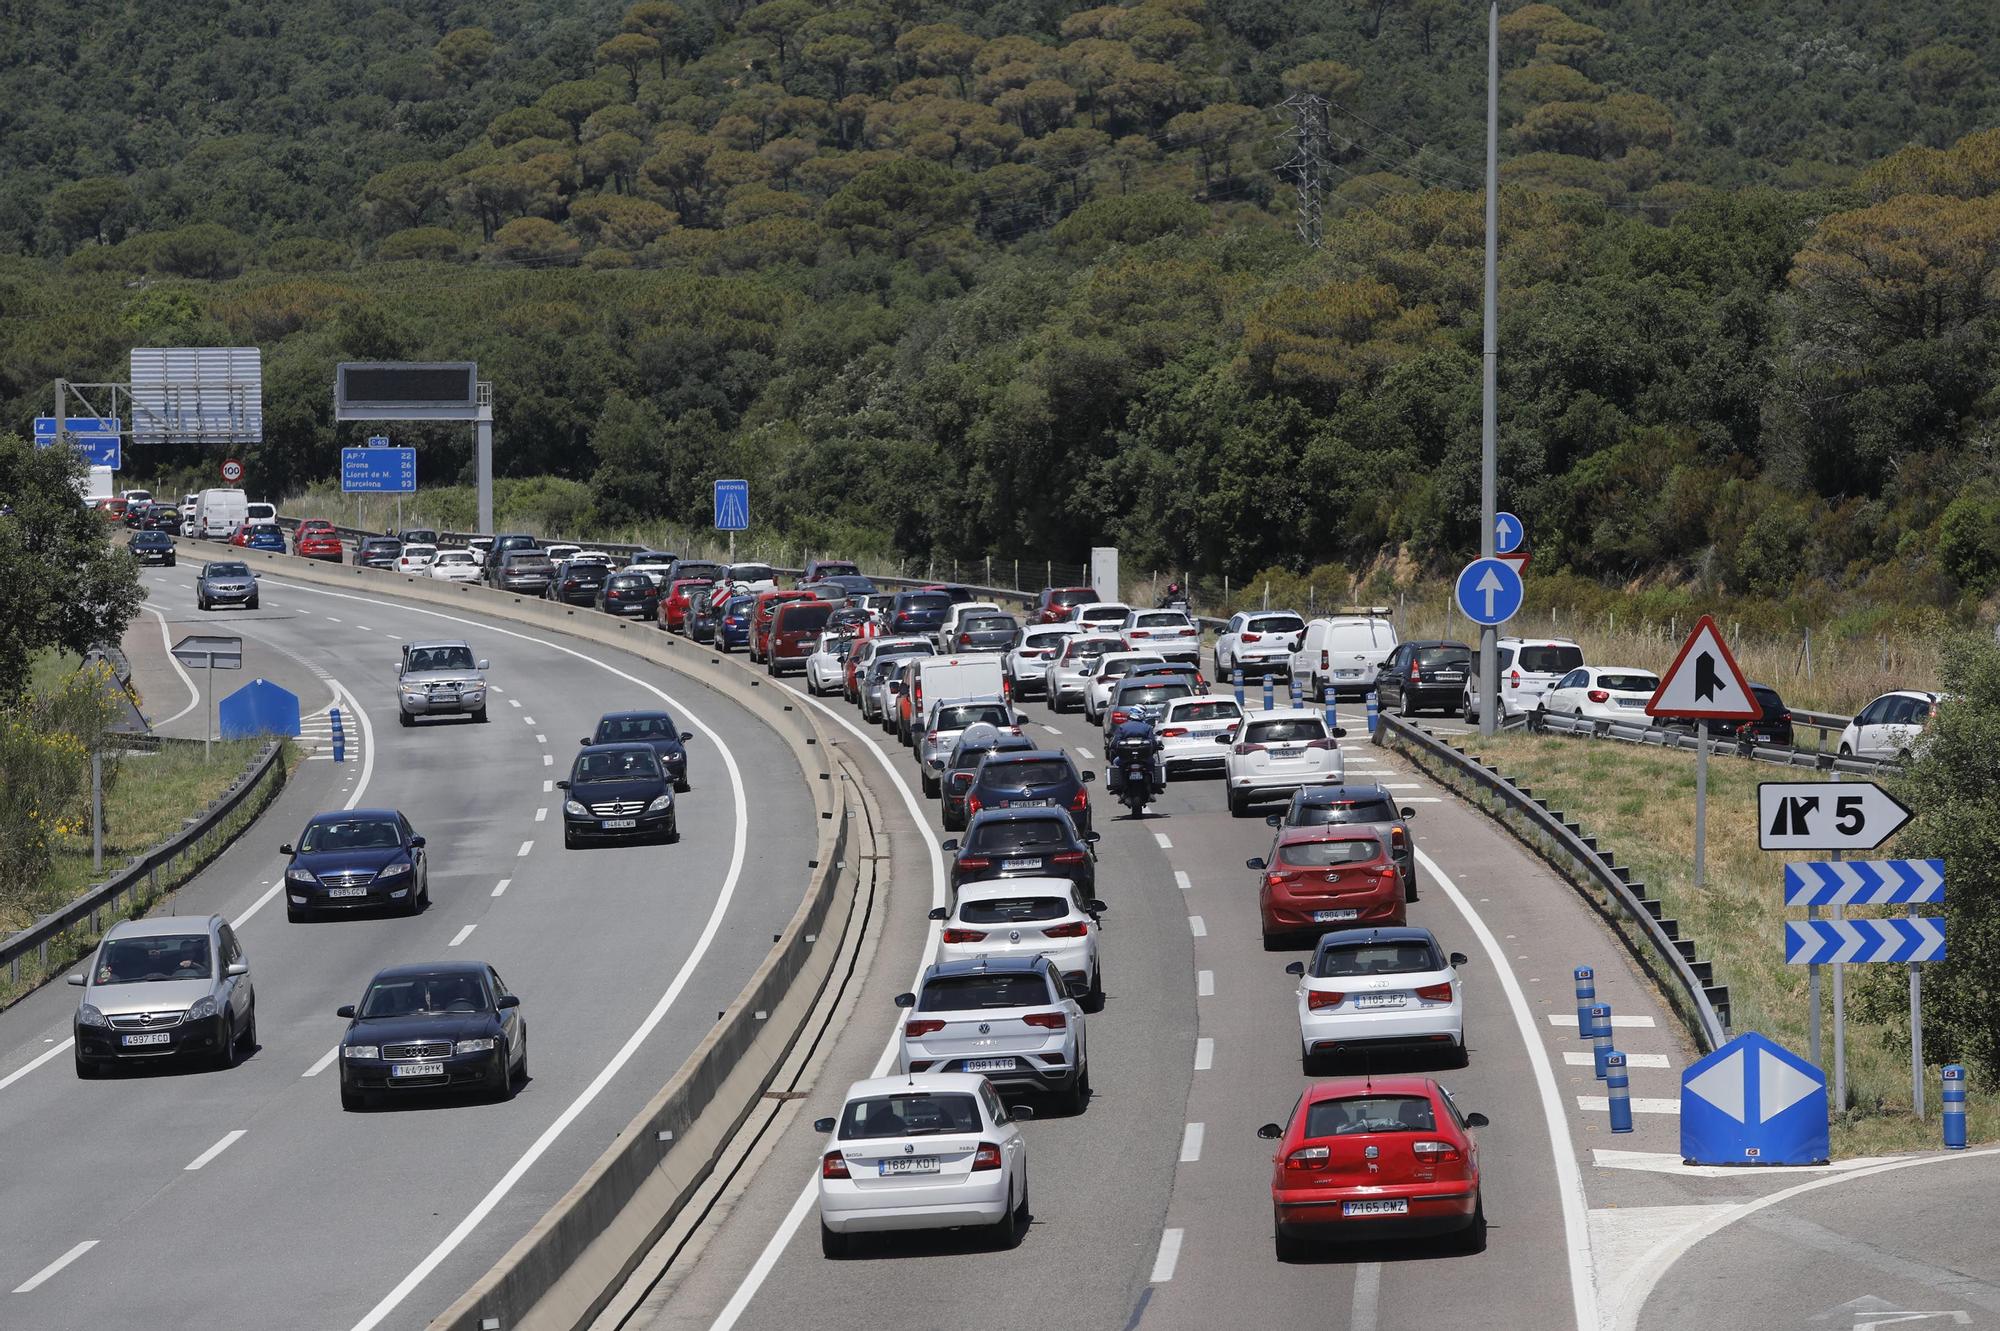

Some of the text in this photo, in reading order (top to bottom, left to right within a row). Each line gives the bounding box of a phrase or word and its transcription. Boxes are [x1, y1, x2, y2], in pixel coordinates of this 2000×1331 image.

[224, 467, 240, 475] 100
[1835, 796, 1866, 836] 5
[1362, 994, 1404, 1004] 1105 JFZ
[127, 1033, 169, 1044] 4997 FCD
[995, 1059, 1014, 1068] KTG
[887, 1158, 936, 1171] 1687 KDT
[1351, 1200, 1405, 1213] 7165 CMZ
